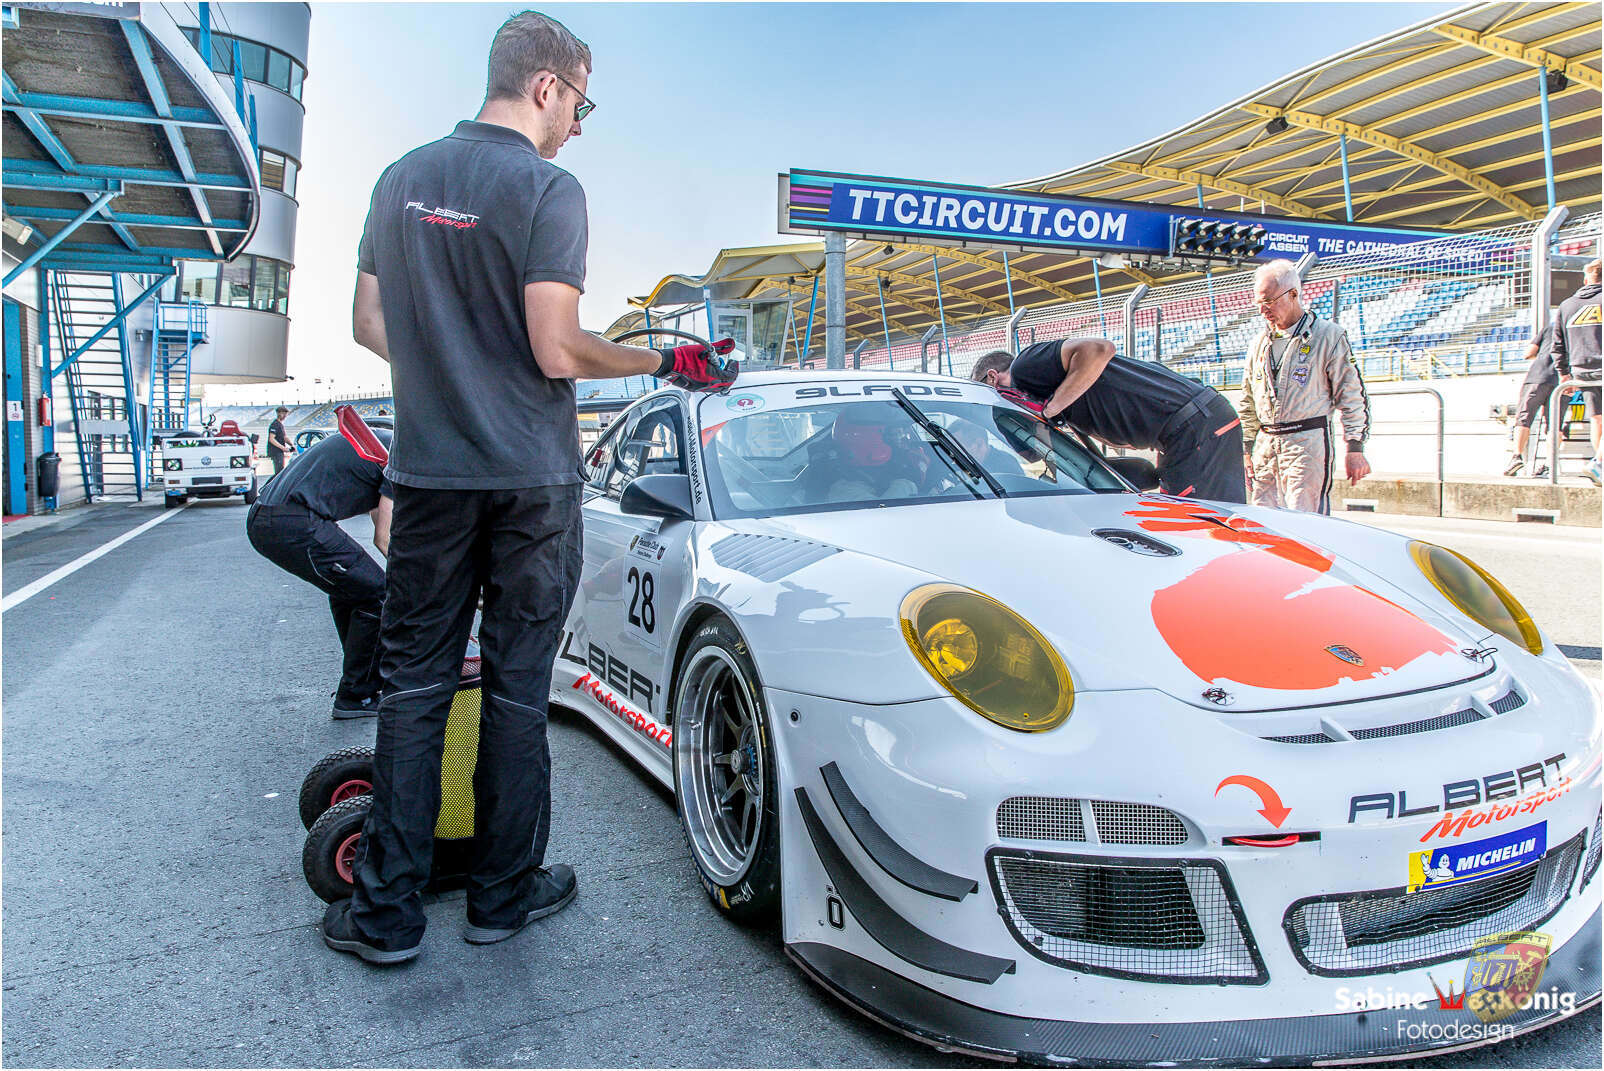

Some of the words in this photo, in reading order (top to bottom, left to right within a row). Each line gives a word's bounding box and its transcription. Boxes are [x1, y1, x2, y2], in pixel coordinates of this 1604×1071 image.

[405, 201, 480, 223] ALBERT
[849, 189, 1127, 241] TTCIRCUIT.COM
[1268, 232, 1310, 244] CIRCUIT
[1268, 242, 1309, 253] ASSEN
[1318, 238, 1345, 253] THE
[627, 566, 656, 634] 28
[559, 629, 661, 714] LBER
[1348, 752, 1566, 824] ALBERT
[1419, 776, 1574, 842] Motorsport
[1456, 838, 1537, 872] MICHELIN
